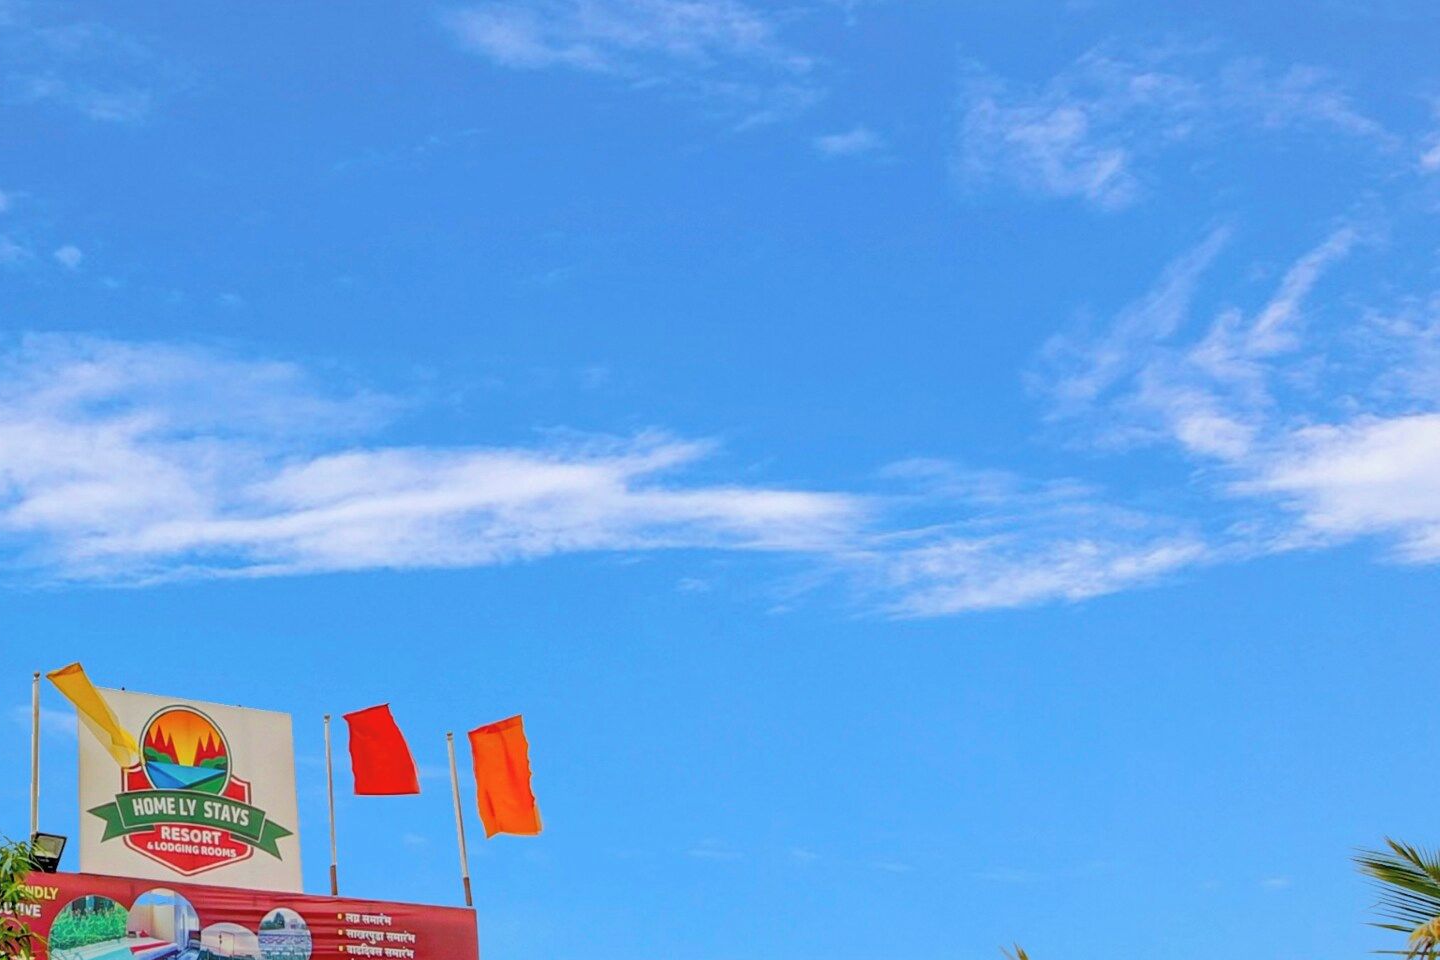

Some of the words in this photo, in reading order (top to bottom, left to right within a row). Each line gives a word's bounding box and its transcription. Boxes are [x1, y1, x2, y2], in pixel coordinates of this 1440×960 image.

[132, 798, 176, 816] HOME
[179, 798, 197, 816] LY
[203, 802, 249, 826] STAYS
[160, 826, 222, 845] RESORT
[146, 842, 155, 850] &
[155, 843, 200, 855] LODGING
[200, 845, 237, 858] ROOMS
